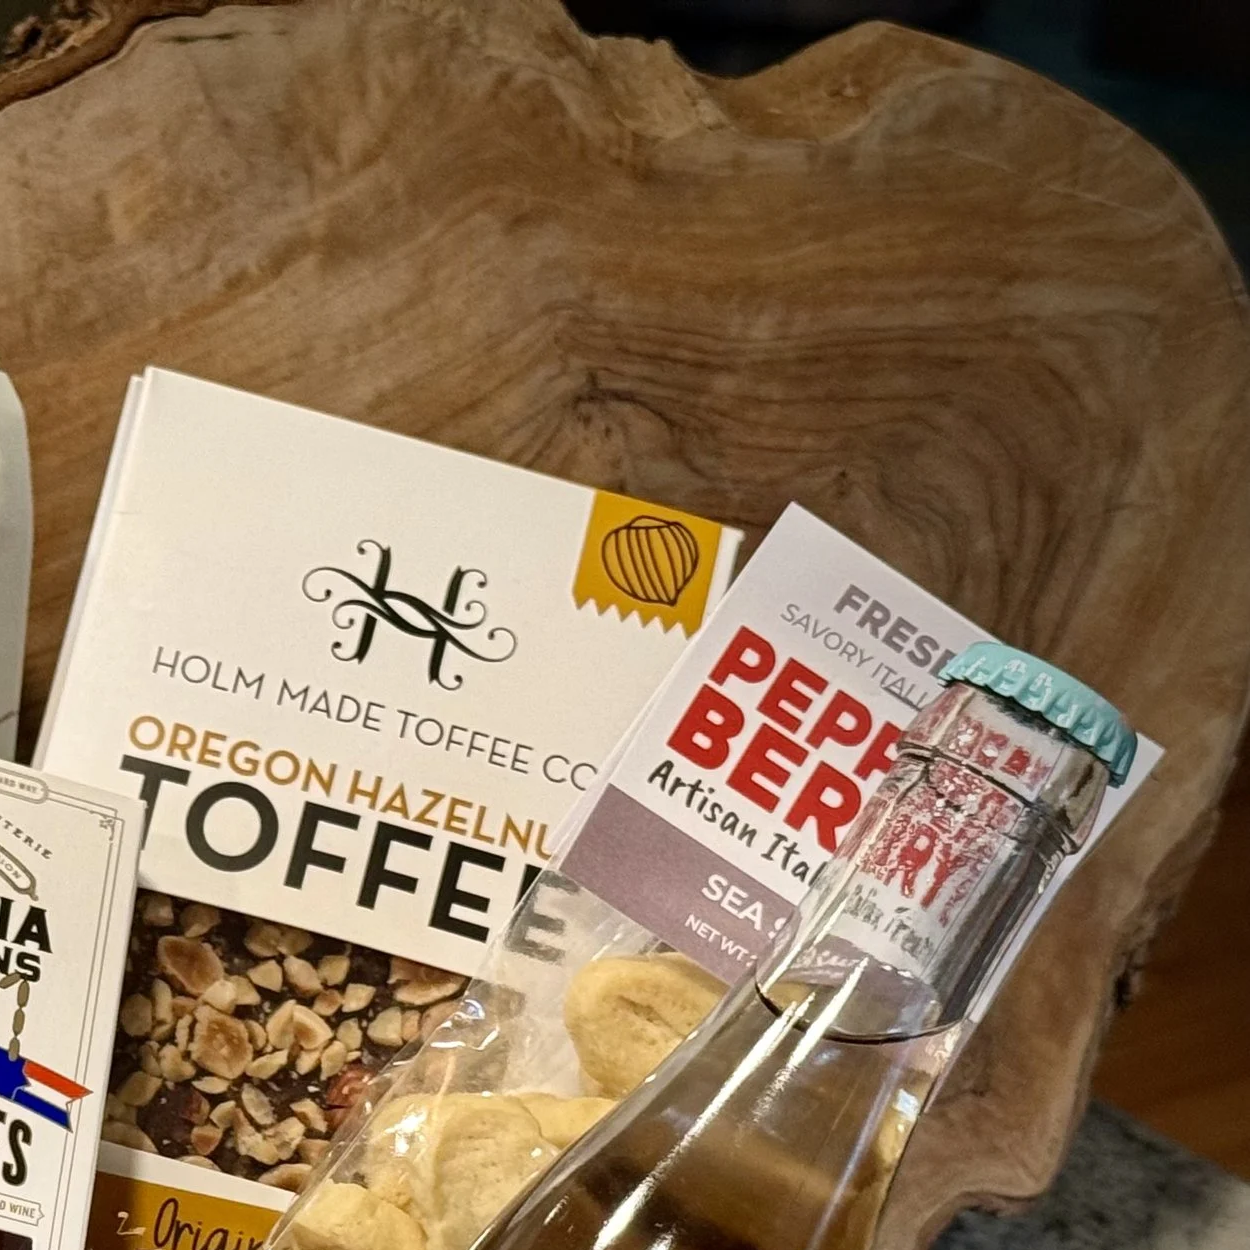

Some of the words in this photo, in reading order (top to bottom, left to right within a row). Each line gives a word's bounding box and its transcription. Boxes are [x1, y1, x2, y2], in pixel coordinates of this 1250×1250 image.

[780, 603, 874, 668] SAVORY
[152, 646, 265, 700] HOLM
[276, 678, 385, 732] MADE
[397, 709, 534, 774] TOFFEE
[708, 625, 907, 780] PEPP
[129, 715, 337, 797] OREGON
[346, 769, 551, 860] HAZELNU
[647, 759, 757, 848] Artisan
[760, 832, 829, 887] Ital
[666, 683, 862, 854] BER
[119, 754, 582, 965] TOFFEE
[701, 874, 763, 931] SEA
[684, 914, 721, 942] NET
[9, 1202, 37, 1219] WINE
